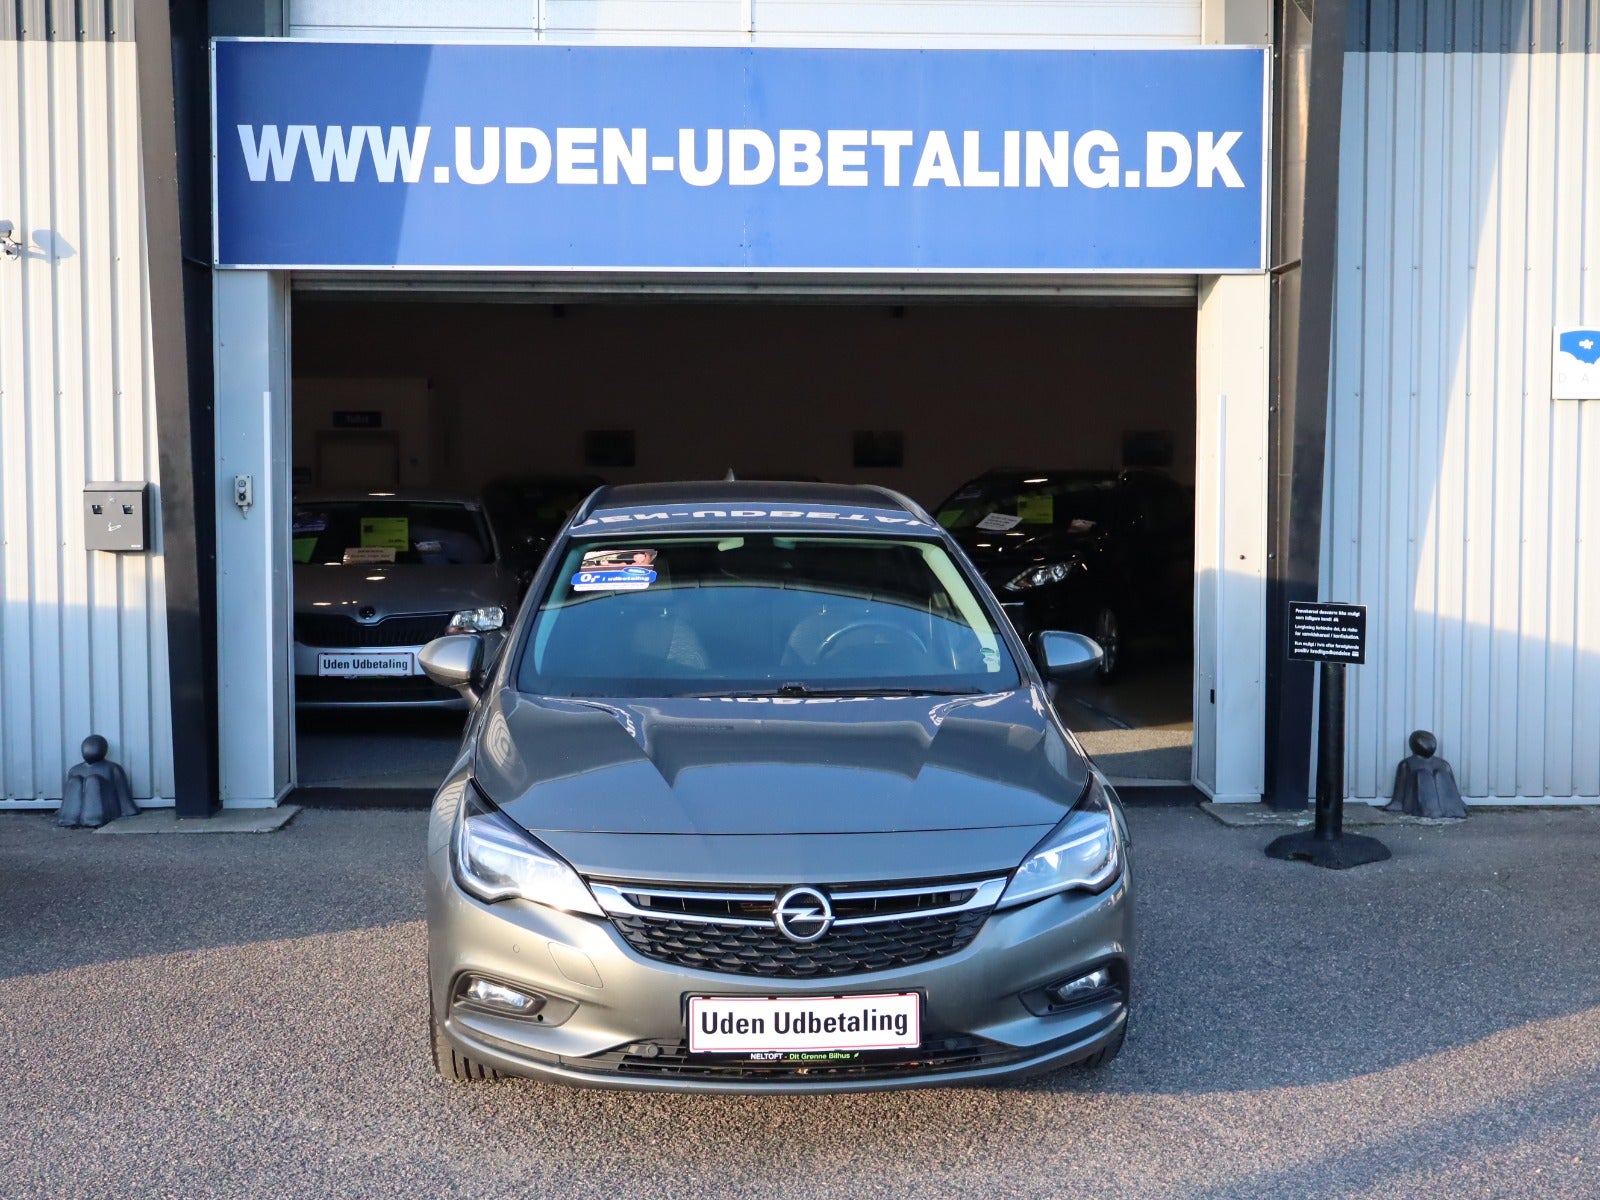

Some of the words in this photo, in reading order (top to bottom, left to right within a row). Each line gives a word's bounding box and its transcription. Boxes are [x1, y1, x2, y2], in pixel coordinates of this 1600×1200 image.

[238, 124, 1245, 190] WWW.UDEN-UDBETALING.DK
[323, 659, 350, 669] Uden
[352, 658, 408, 671] Udbetaling
[701, 1011, 765, 1035] Uden
[774, 1008, 908, 1036] Udbetaling
[750, 1052, 783, 1060] NELTOFT
